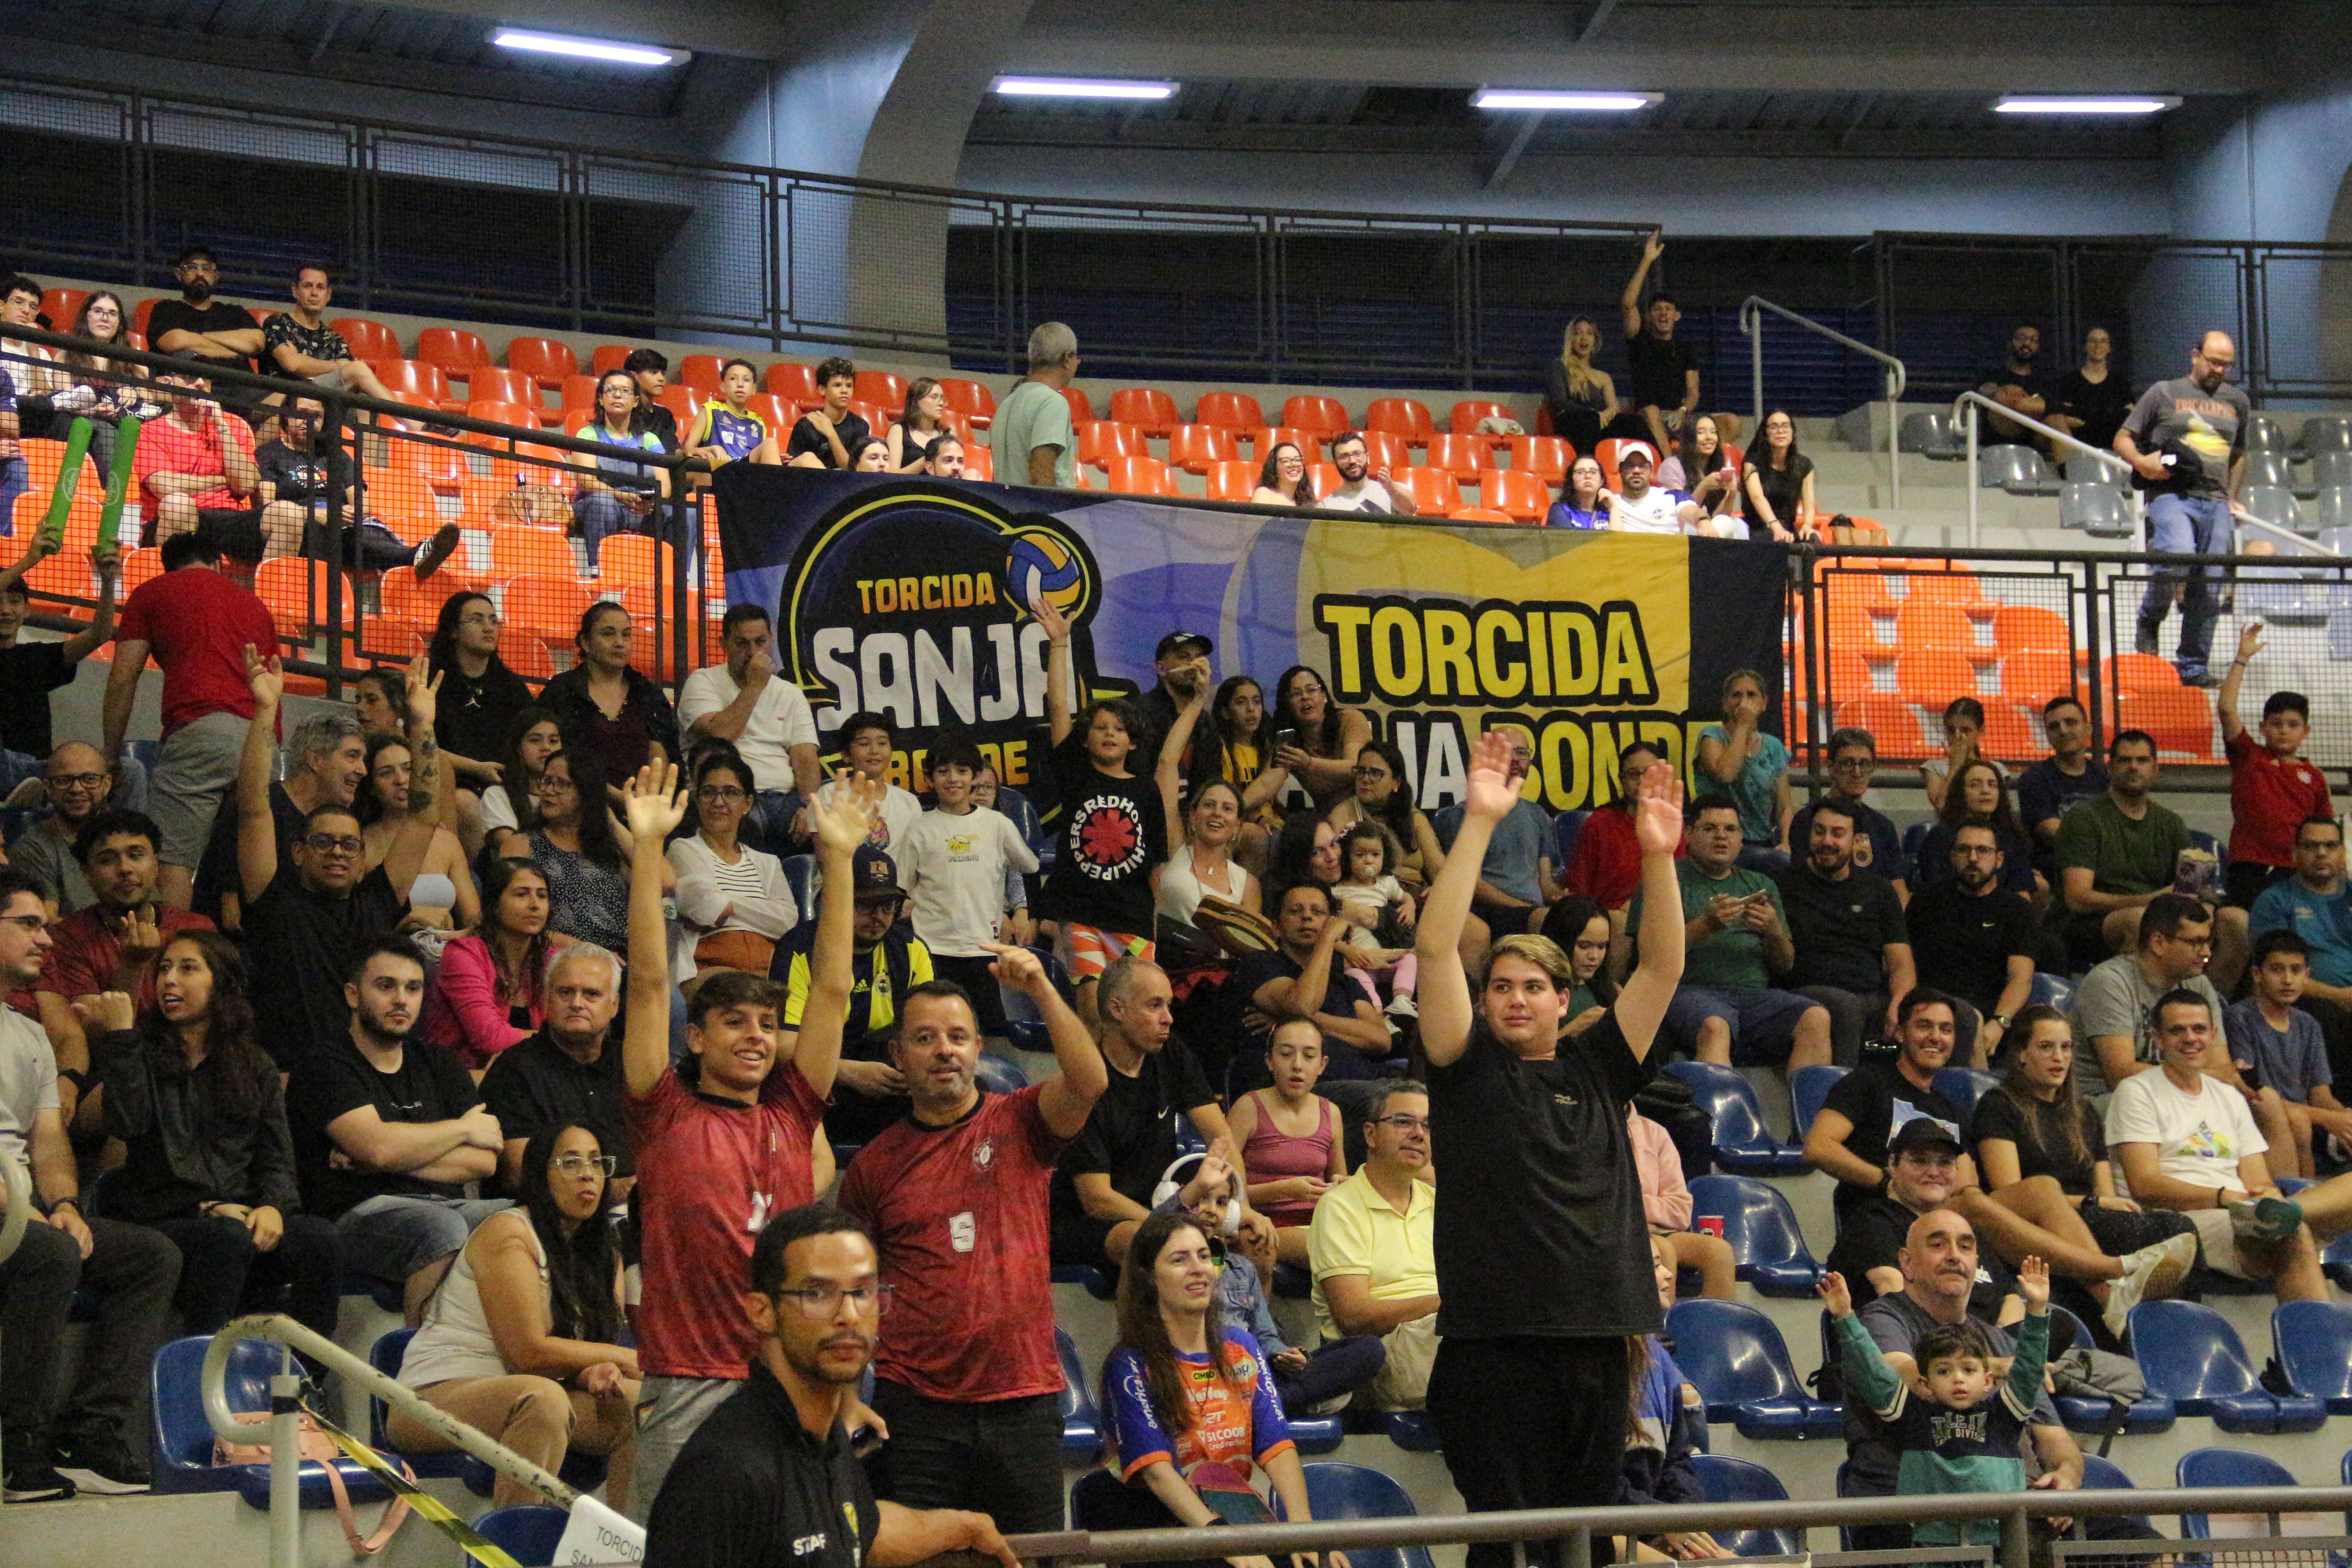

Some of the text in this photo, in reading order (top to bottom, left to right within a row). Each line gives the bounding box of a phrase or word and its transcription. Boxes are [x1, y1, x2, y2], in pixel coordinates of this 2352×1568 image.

[857, 571, 997, 615] TORCIDA
[813, 622, 1078, 732] SANJA
[1322, 604, 1650, 697] TORCIDA
[1207, 1427, 1245, 1443] SICOOB
